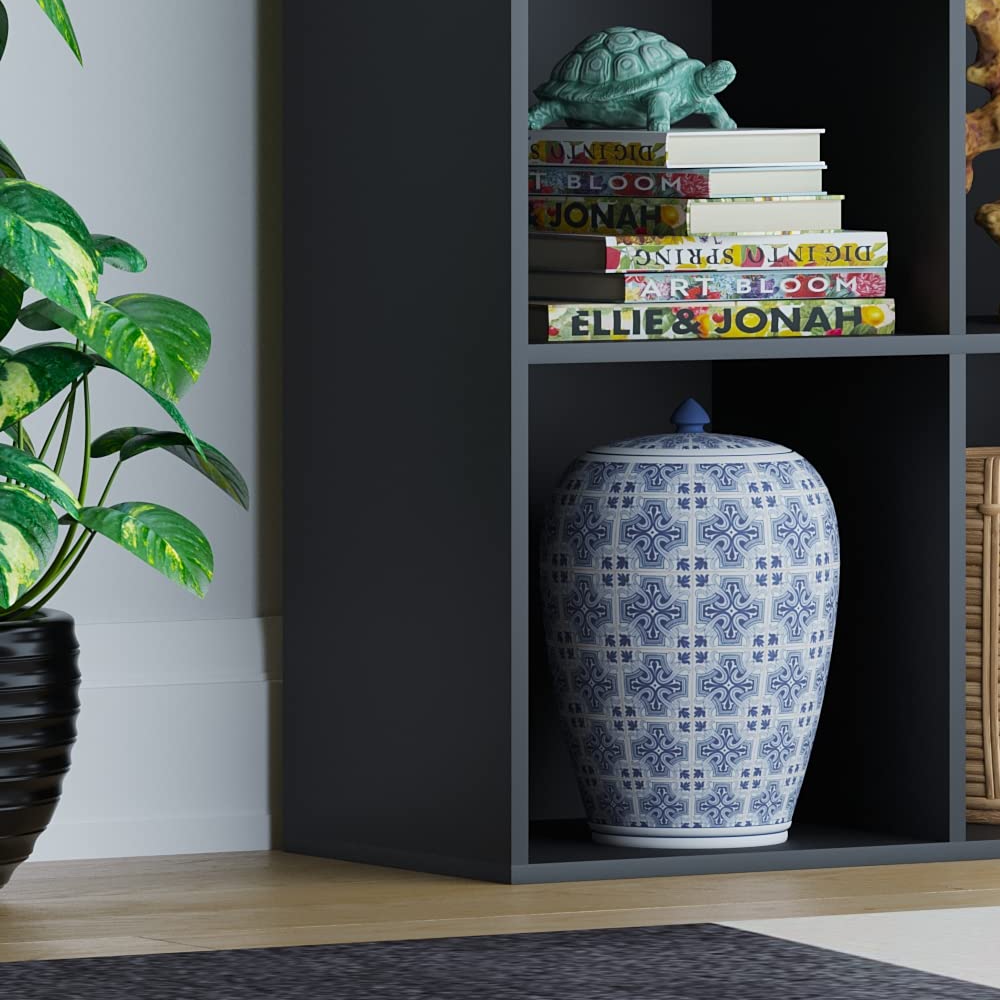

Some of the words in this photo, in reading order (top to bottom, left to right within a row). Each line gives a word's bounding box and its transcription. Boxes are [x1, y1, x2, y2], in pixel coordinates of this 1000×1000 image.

[615, 145, 653, 161] DIG
[568, 173, 681, 192] BLOOM
[550, 202, 660, 229] JONAH
[635, 247, 734, 266] SPRING
[748, 245, 815, 263] INTO
[826, 245, 872, 262] DIG
[641, 277, 713, 297] ART
[737, 277, 860, 297] BLOOM
[571, 307, 664, 336] ELLIE
[672, 307, 700, 334] &
[715, 306, 862, 335] JONAH
